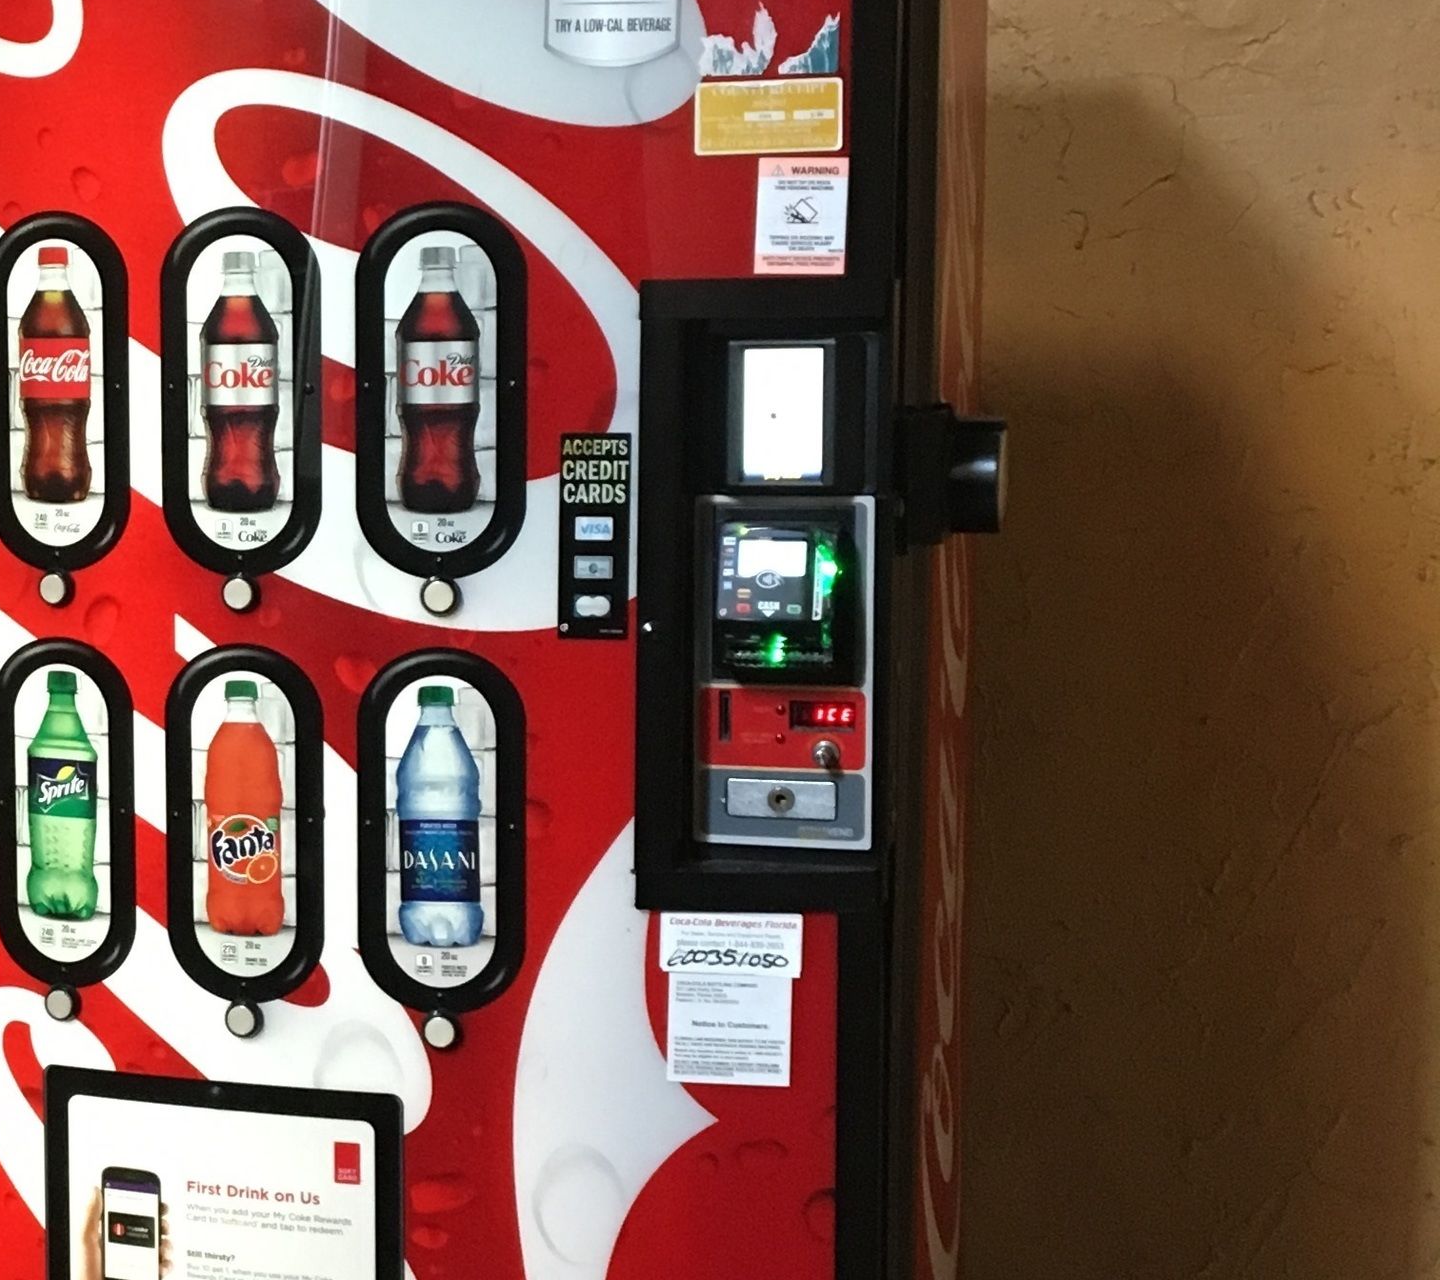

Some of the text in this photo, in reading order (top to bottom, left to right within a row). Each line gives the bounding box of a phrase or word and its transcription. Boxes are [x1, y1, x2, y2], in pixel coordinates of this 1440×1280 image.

[555, 18, 672, 33] TRY A LOW-CAL BEVERAGE
[791, 166, 840, 175] WARNING
[20, 349, 90, 382] Coca-Cola
[204, 361, 273, 389] Coke
[400, 358, 475, 387] Coke
[562, 439, 628, 456] ACCEPTS
[562, 460, 629, 480] CREDIT
[563, 484, 626, 503] CARDS
[580, 524, 610, 534] VISA
[758, 601, 780, 610] CASH
[817, 709, 852, 722] ICE
[38, 774, 85, 805] Sprite
[211, 825, 275, 871] Fanta
[404, 848, 475, 872] DASANI
[670, 917, 797, 929] Coca-Cola Beverages Florida
[691, 1020, 716, 1028] Notice
[187, 1181, 321, 1205] First Drink on Us
[186, 1203, 352, 1226] When you add your My Coke Rewards
[186, 1214, 206, 1223] Card
[209, 1215, 218, 1223] to
[261, 1221, 277, 1230] and
[280, 1223, 295, 1233] tap
[297, 1224, 307, 1232] to
[187, 1250, 235, 1263] Still thirsty?
